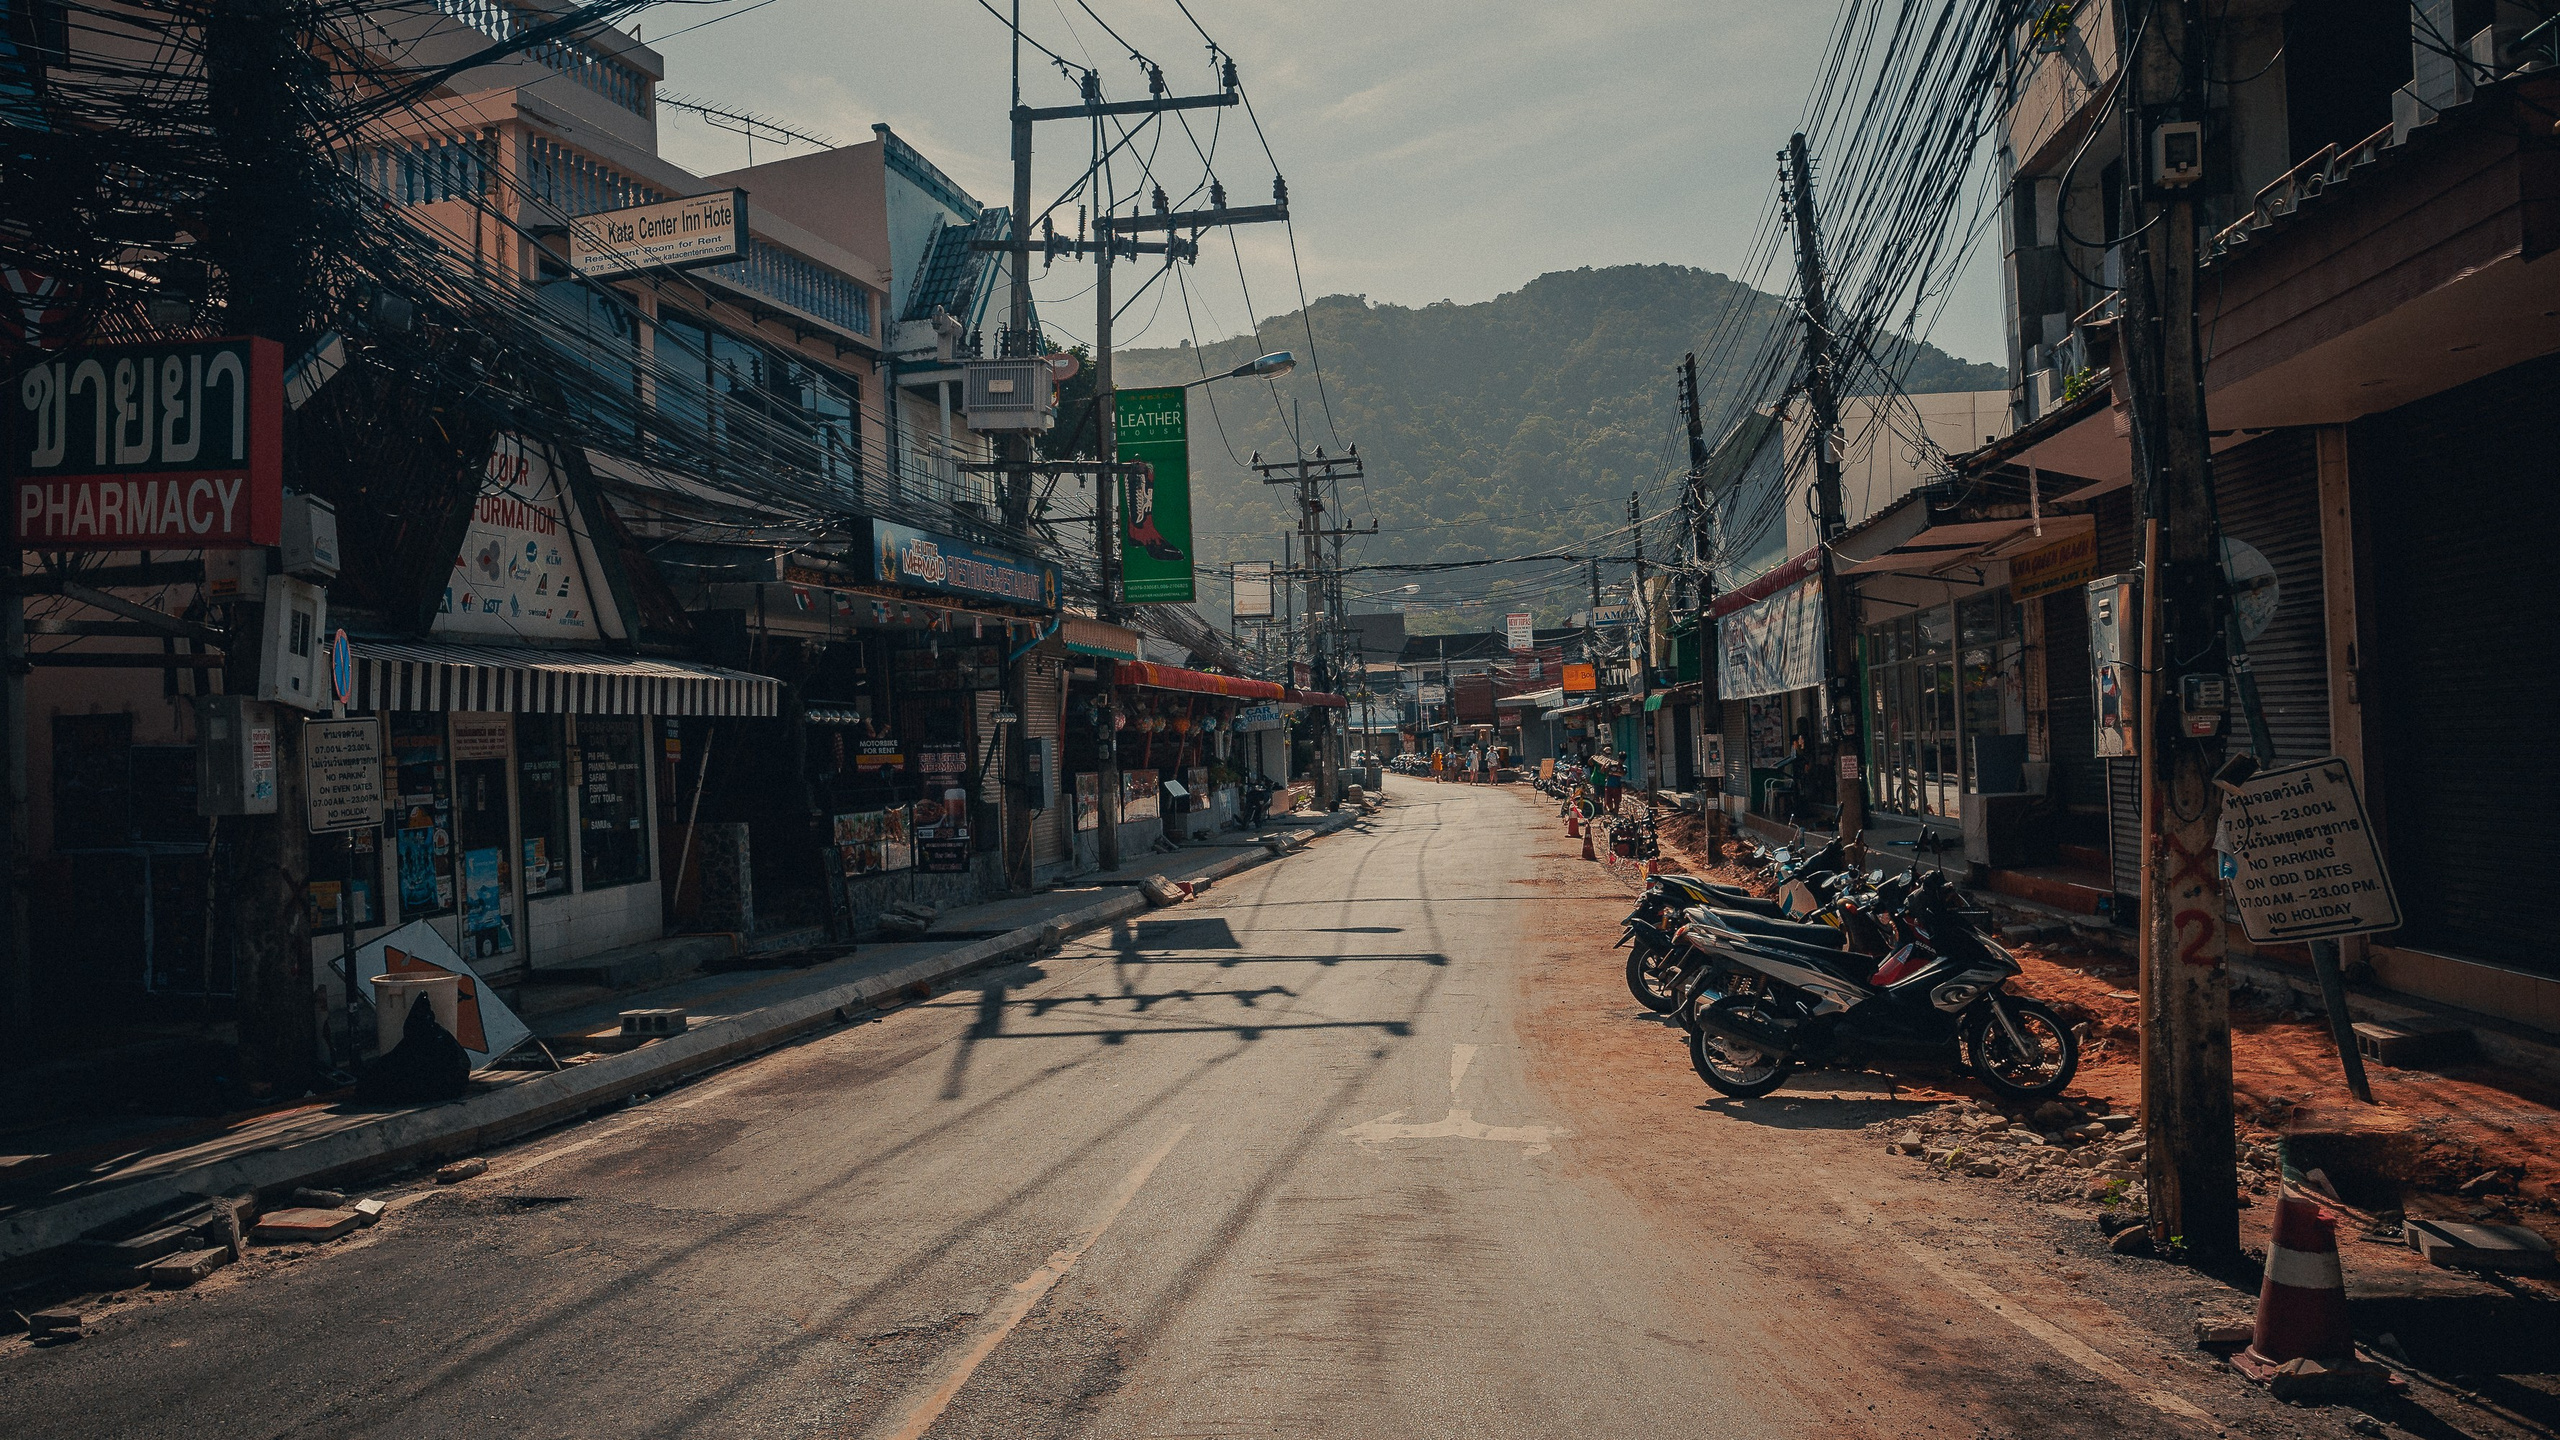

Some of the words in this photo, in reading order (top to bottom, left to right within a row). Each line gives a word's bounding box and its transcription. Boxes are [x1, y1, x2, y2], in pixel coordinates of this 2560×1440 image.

[607, 222, 634, 244] Kata
[639, 216, 678, 239] Center
[682, 210, 701, 232] Inn
[644, 242, 674, 254] Room
[679, 240, 694, 249] for
[698, 235, 722, 245] Rent
[21, 350, 245, 468] ขายยา
[1119, 402, 1181, 411] KATA
[1120, 411, 1181, 428] LEATHER
[1120, 427, 1182, 436] HOUSE
[488, 452, 529, 486] TOUR
[21, 478, 242, 537] PHARMACY
[472, 495, 557, 536] FORMATION
[546, 553, 562, 565] KLM
[902, 547, 946, 585] MERMAID
[559, 618, 568, 626] AIR
[568, 619, 585, 627] FRANCE
[1246, 707, 1271, 716] CAR
[937, 752, 966, 762] LITTLE
[919, 762, 966, 773] MERMAID
[338, 771, 366, 780] PARKING
[589, 773, 607, 782] SAFARI
[320, 786, 330, 794] ON
[333, 785, 351, 793] EVEN
[353, 783, 373, 791] DATES
[589, 784, 608, 793] FISHING
[590, 796, 601, 804] CITY
[602, 794, 616, 803] TOUR
[328, 810, 338, 818] NO
[341, 807, 368, 816] HOLIDAY
[591, 820, 607, 830] SAMUI
[2249, 858, 2268, 871] NO
[2273, 847, 2335, 867] PARKING
[2246, 877, 2265, 891] ON
[2270, 872, 2299, 887] ODD
[2304, 863, 2353, 880] DATES
[2267, 912, 2287, 925] NO
[2292, 902, 2352, 922] HOLIDAY
[2174, 909, 2220, 966] 2
